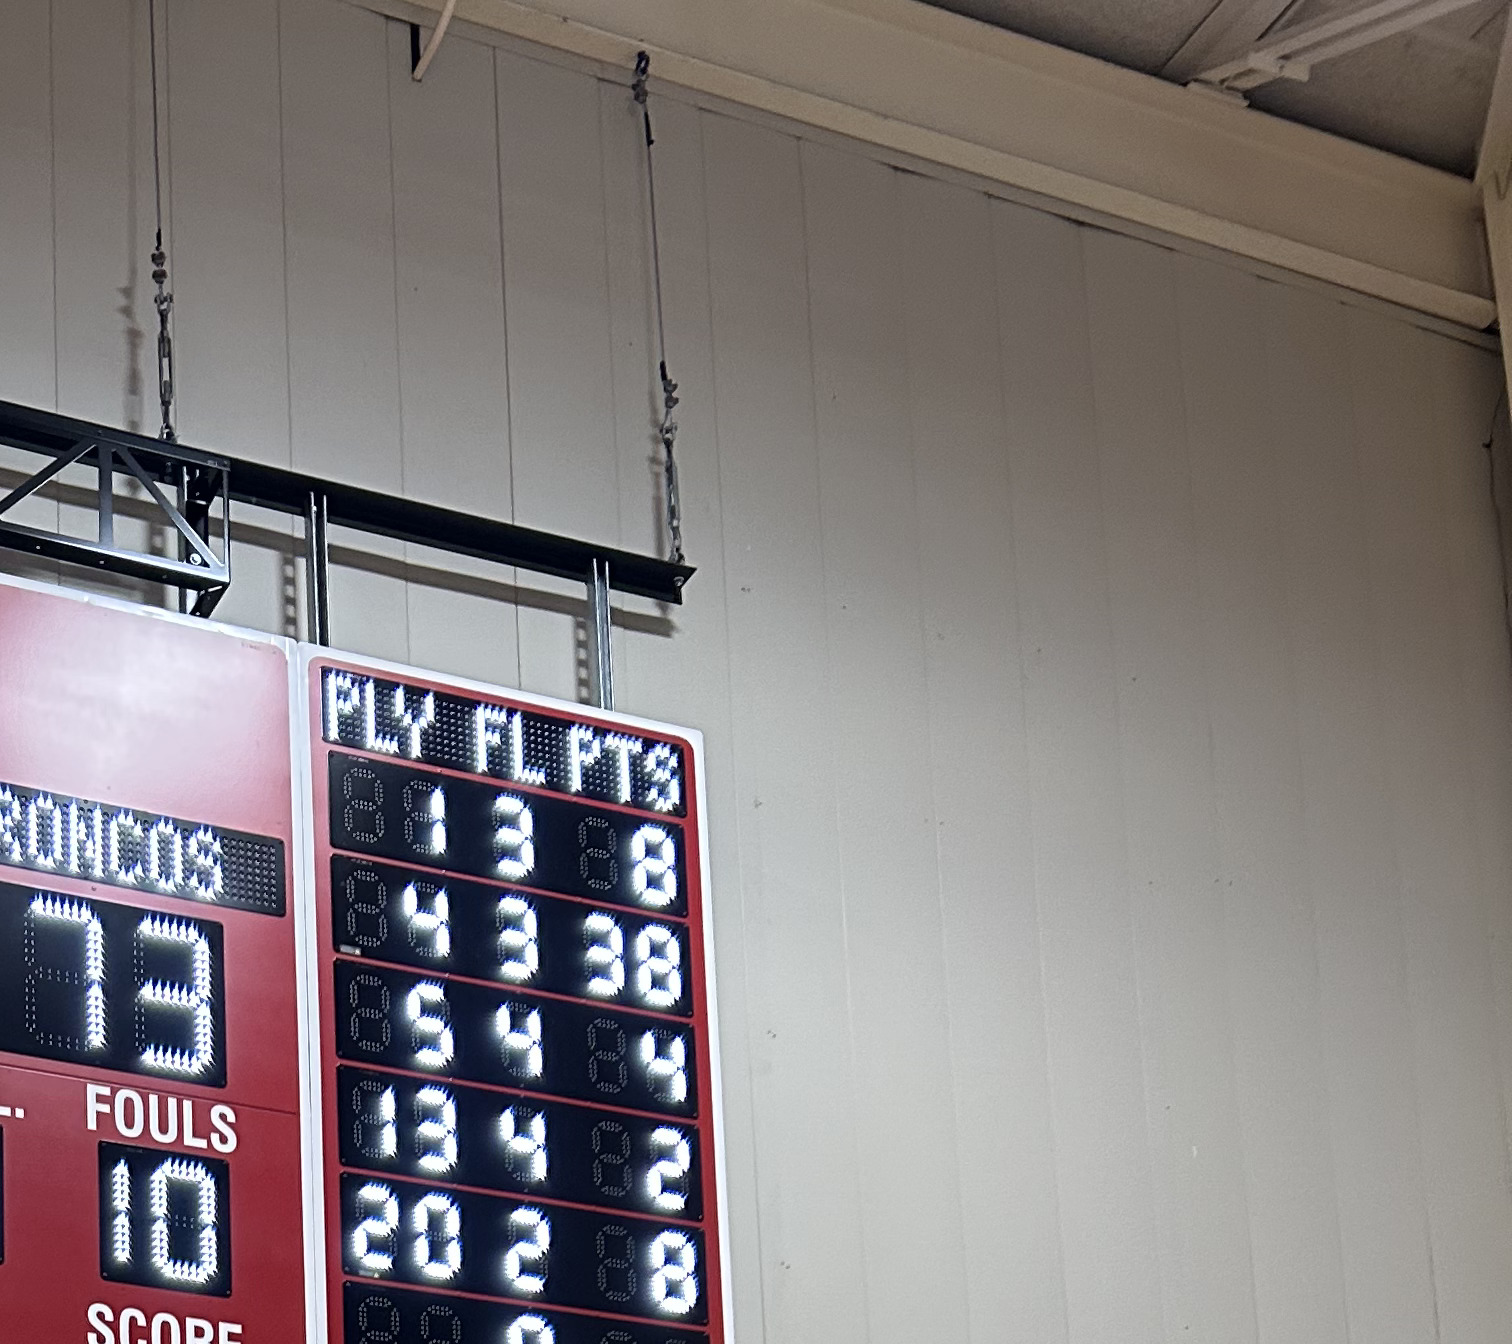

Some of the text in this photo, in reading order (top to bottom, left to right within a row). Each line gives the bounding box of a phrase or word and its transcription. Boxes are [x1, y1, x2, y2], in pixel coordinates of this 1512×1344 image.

[327, 668, 681, 813] PLY FL PTS
[429, 787, 676, 907] 1 3 8
[28, 891, 214, 1077] 73
[402, 883, 681, 1007] 4 3 38
[406, 982, 686, 1102] 5 4 4
[85, 1082, 238, 1154] FOULS
[379, 1086, 690, 1210] 13 4 2
[112, 1157, 220, 1284] 10
[352, 1184, 697, 1314] 20 2 8
